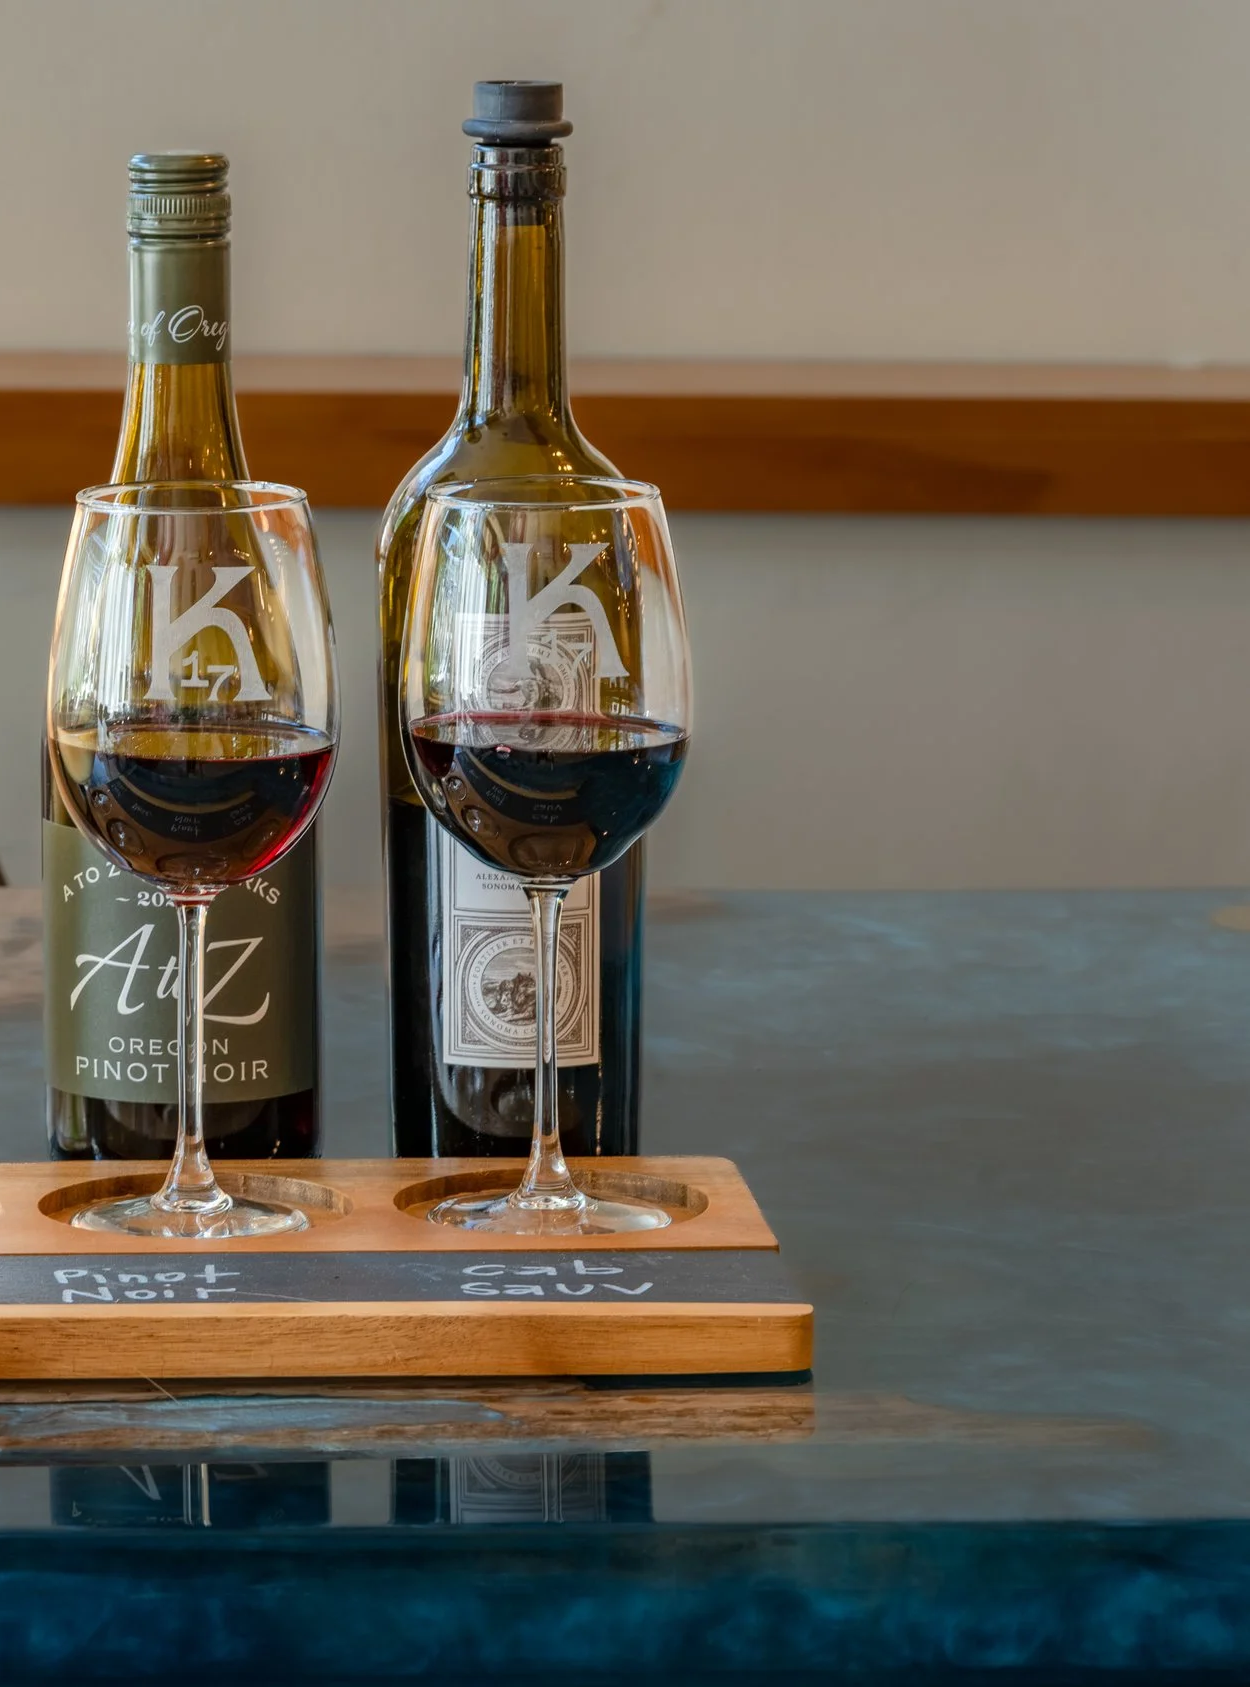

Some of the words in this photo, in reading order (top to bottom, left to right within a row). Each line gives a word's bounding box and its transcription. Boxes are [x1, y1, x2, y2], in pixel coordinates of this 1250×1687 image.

[141, 310, 166, 347] of
[168, 304, 230, 351] Oreg
[501, 542, 630, 678] K
[143, 565, 272, 701] K
[180, 650, 235, 701] 17
[74, 867, 100, 890] TO
[137, 891, 175, 907] 202
[70, 923, 155, 1015] A
[202, 936, 270, 1025] Z
[76, 1056, 169, 1083] PINOT
[54, 1264, 240, 1284] Pinot
[62, 1283, 236, 1303] Noir
